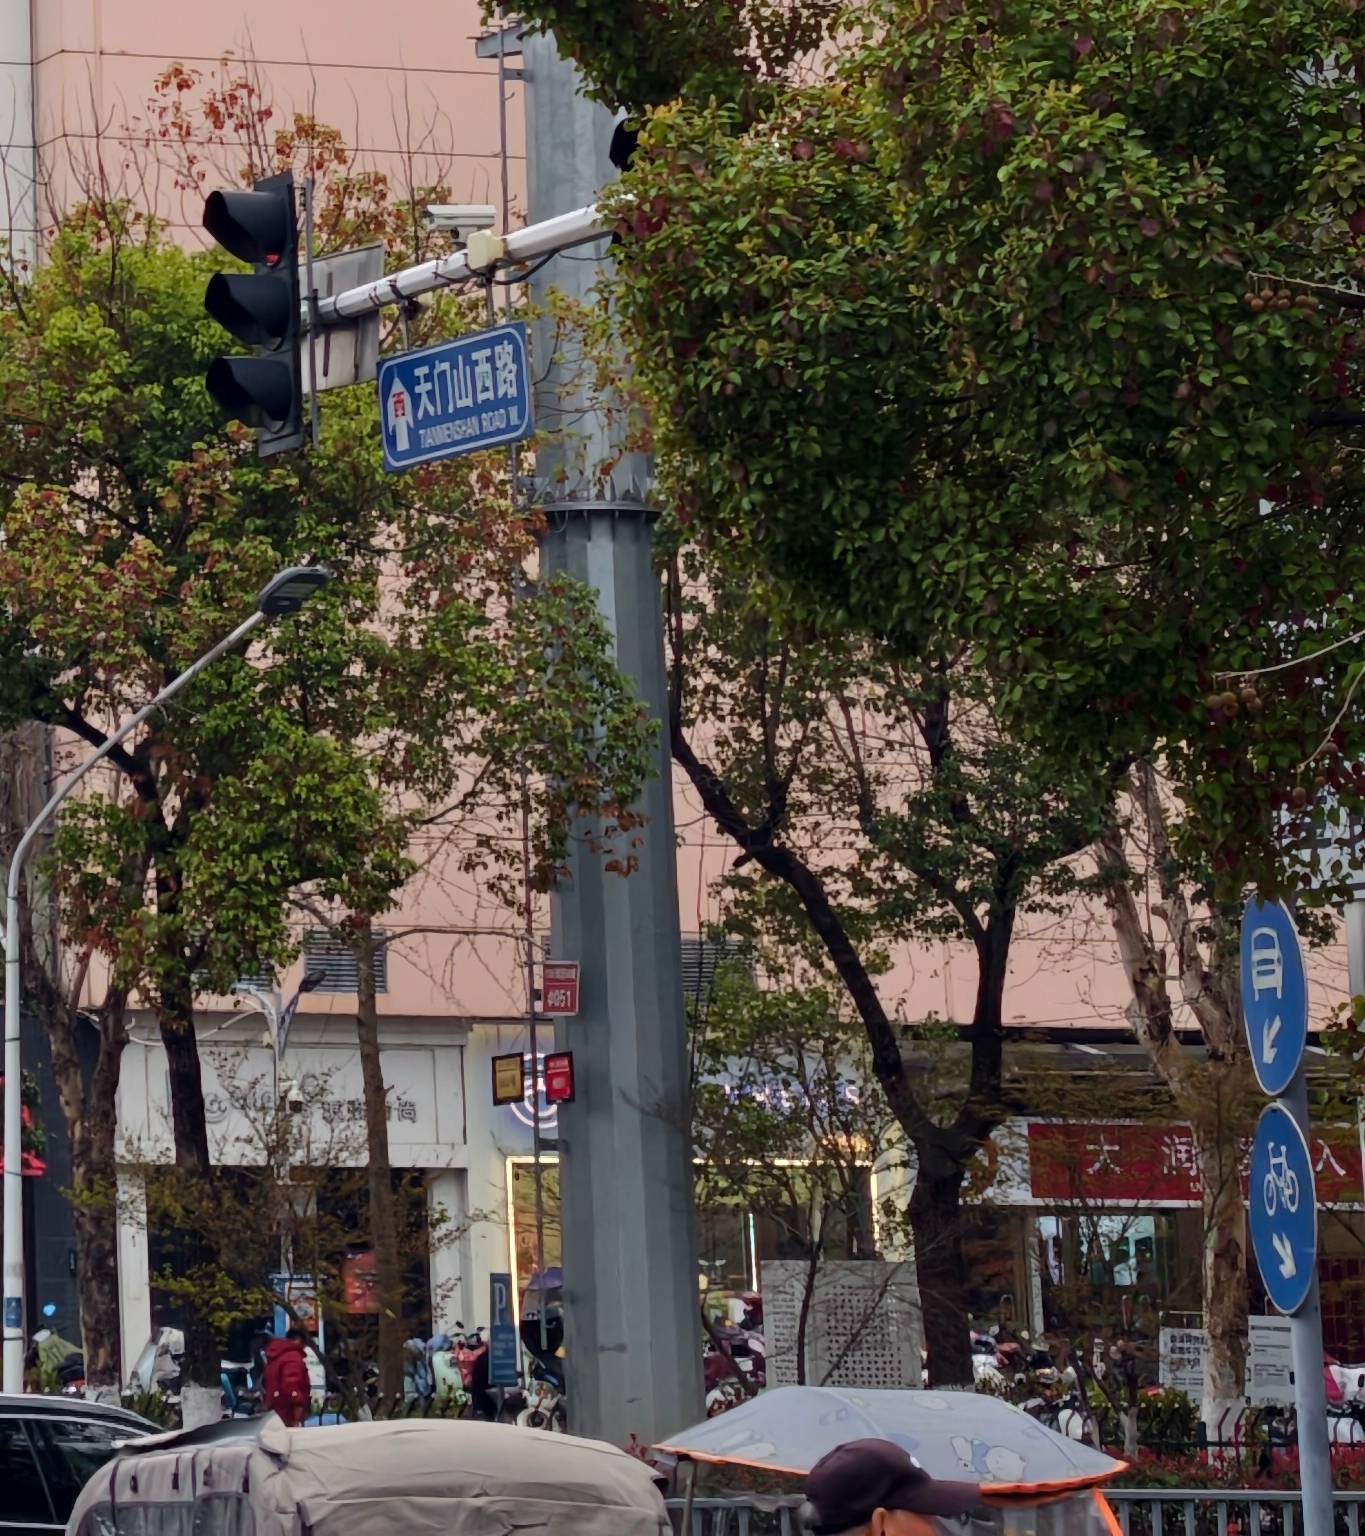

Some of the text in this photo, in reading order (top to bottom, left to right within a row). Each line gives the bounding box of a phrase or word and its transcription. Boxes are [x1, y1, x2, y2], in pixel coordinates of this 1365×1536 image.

[414, 339, 518, 421] 天门山西路
